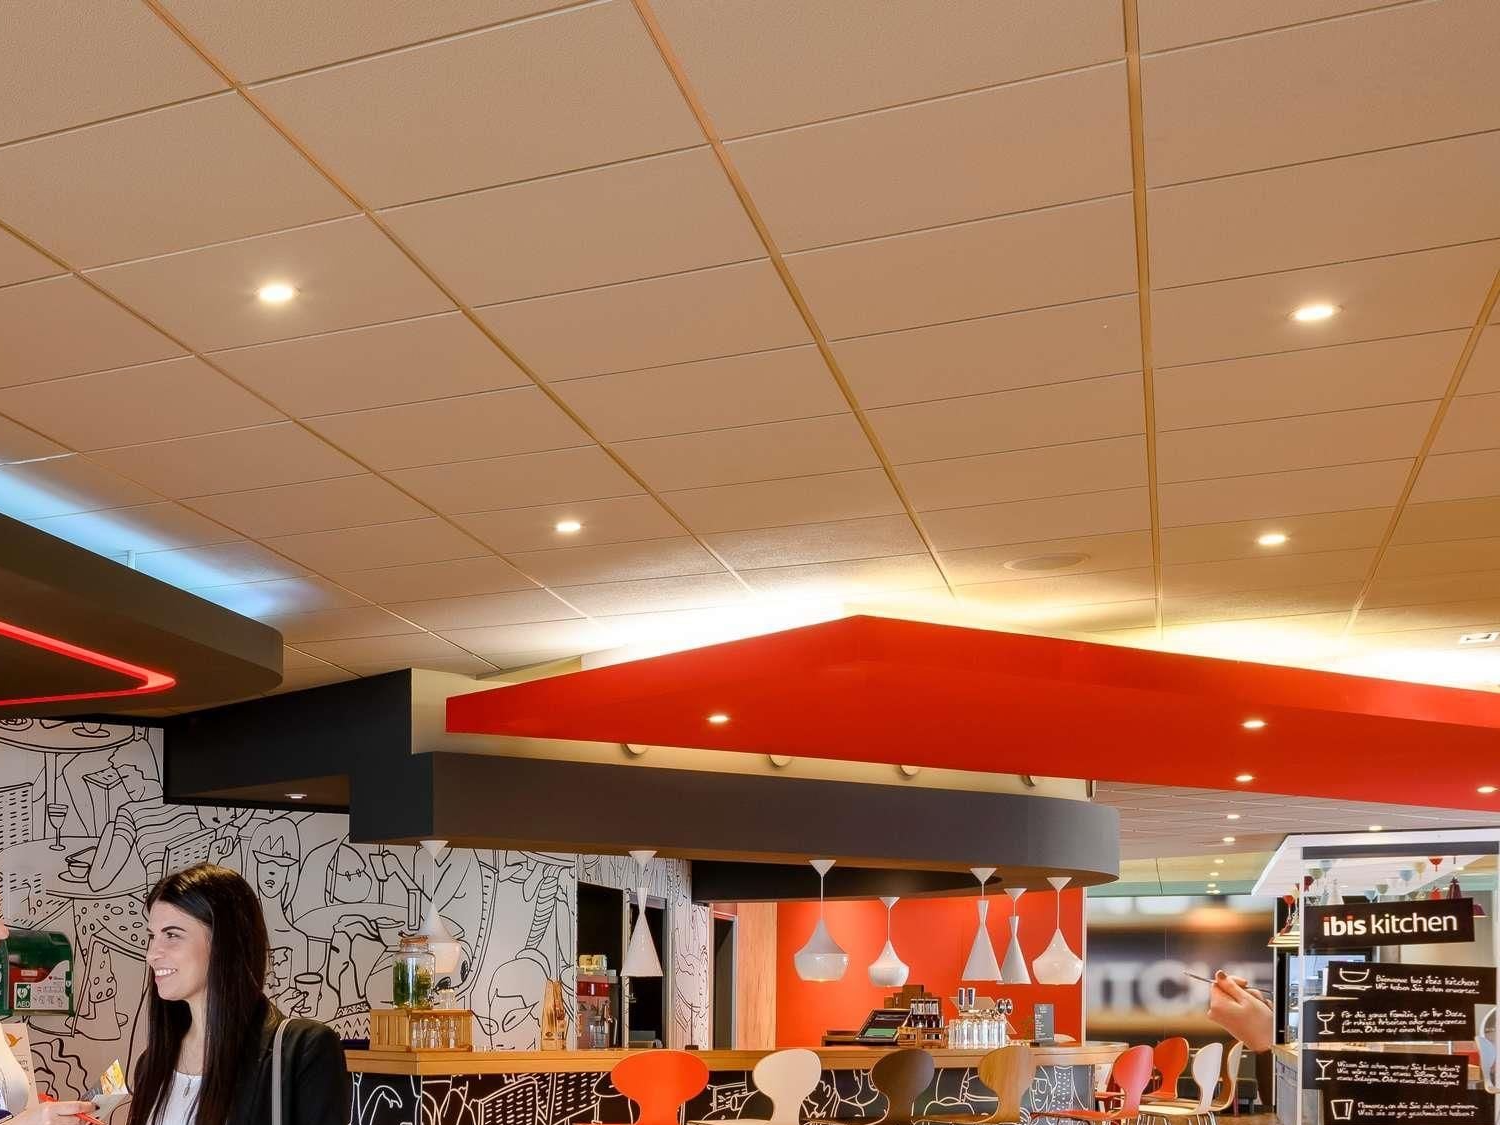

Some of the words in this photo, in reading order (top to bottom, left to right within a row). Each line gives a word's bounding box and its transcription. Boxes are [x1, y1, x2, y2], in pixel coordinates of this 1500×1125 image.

[1324, 915, 1366, 936] ibis
[1371, 912, 1458, 934] kitchen
[1411, 984, 1424, 992] Sie
